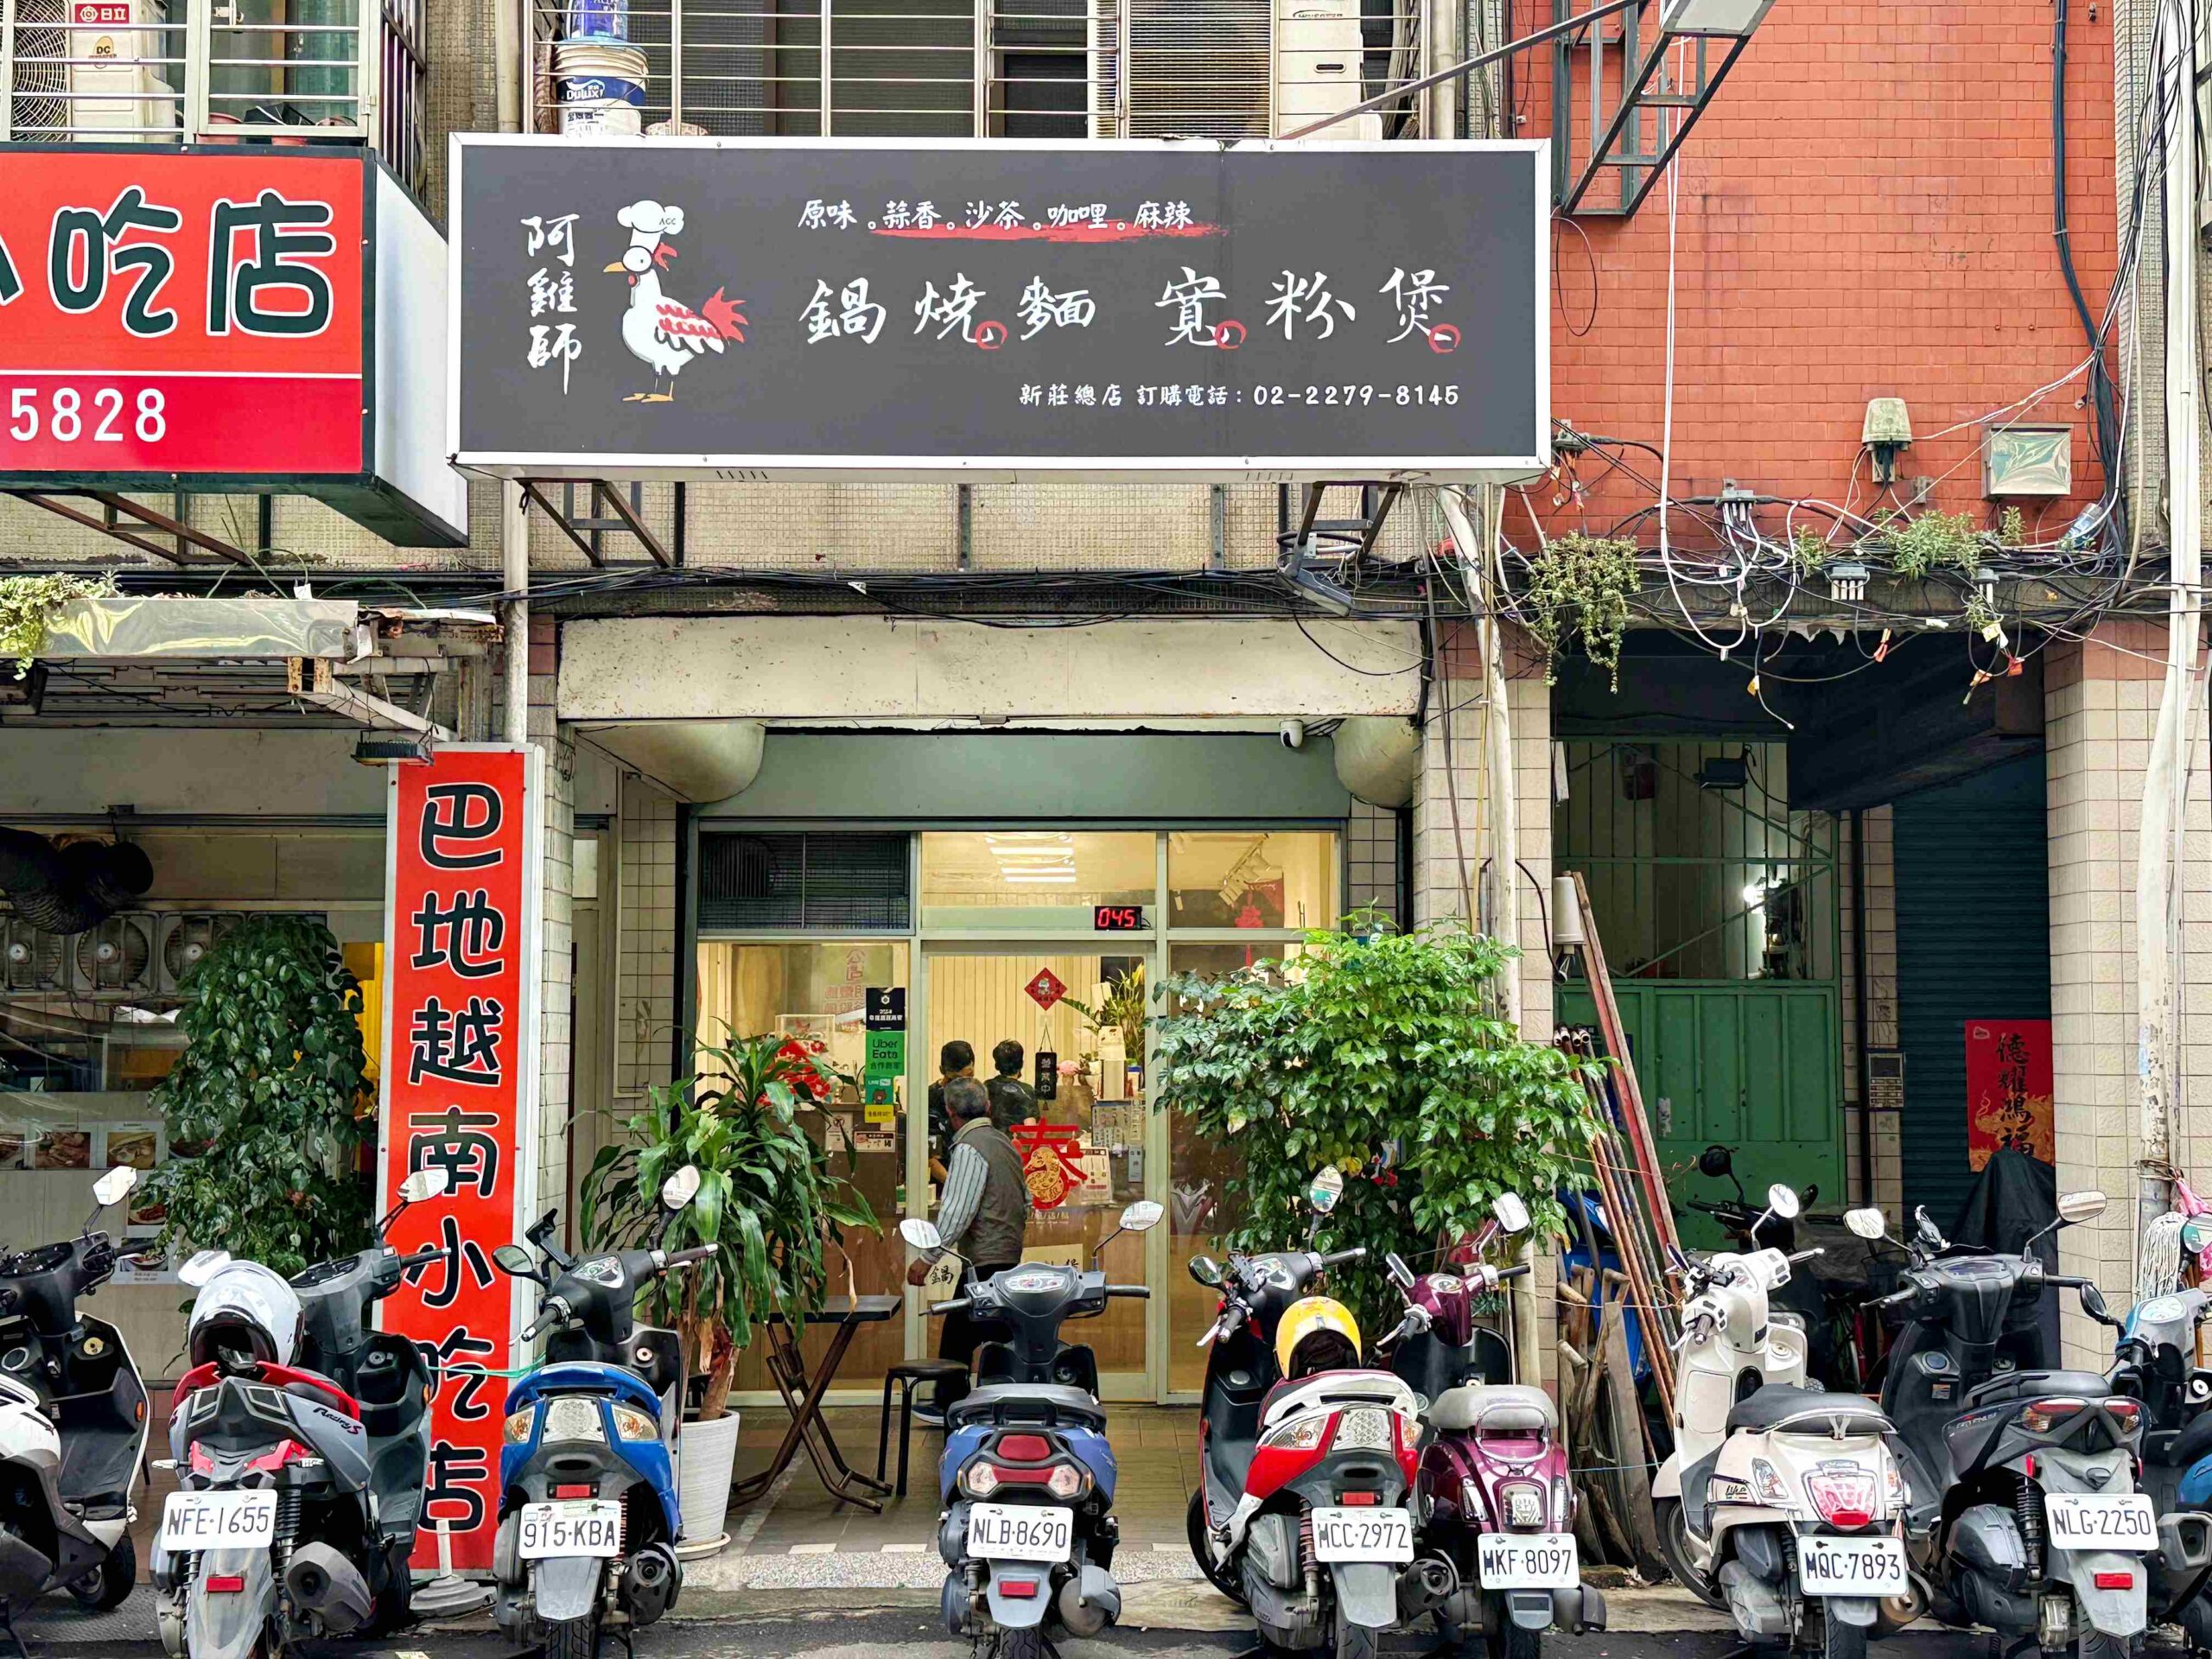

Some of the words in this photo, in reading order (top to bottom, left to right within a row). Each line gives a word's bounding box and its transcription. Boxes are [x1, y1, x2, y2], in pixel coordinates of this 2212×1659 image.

[101, 7, 126, 21] 日立
[96, 45, 111, 54] DC
[0, 185, 336, 338] 吃店
[1019, 383, 1122, 407] 新莊總店
[10, 388, 165, 442] 5828
[1097, 907, 1135, 927] 045
[873, 1039, 898, 1048] Uber
[873, 1049, 898, 1059] Eats
[406, 782, 505, 1533] 巴地越南小吃店
[930, 1265, 953, 1284] 鍋
